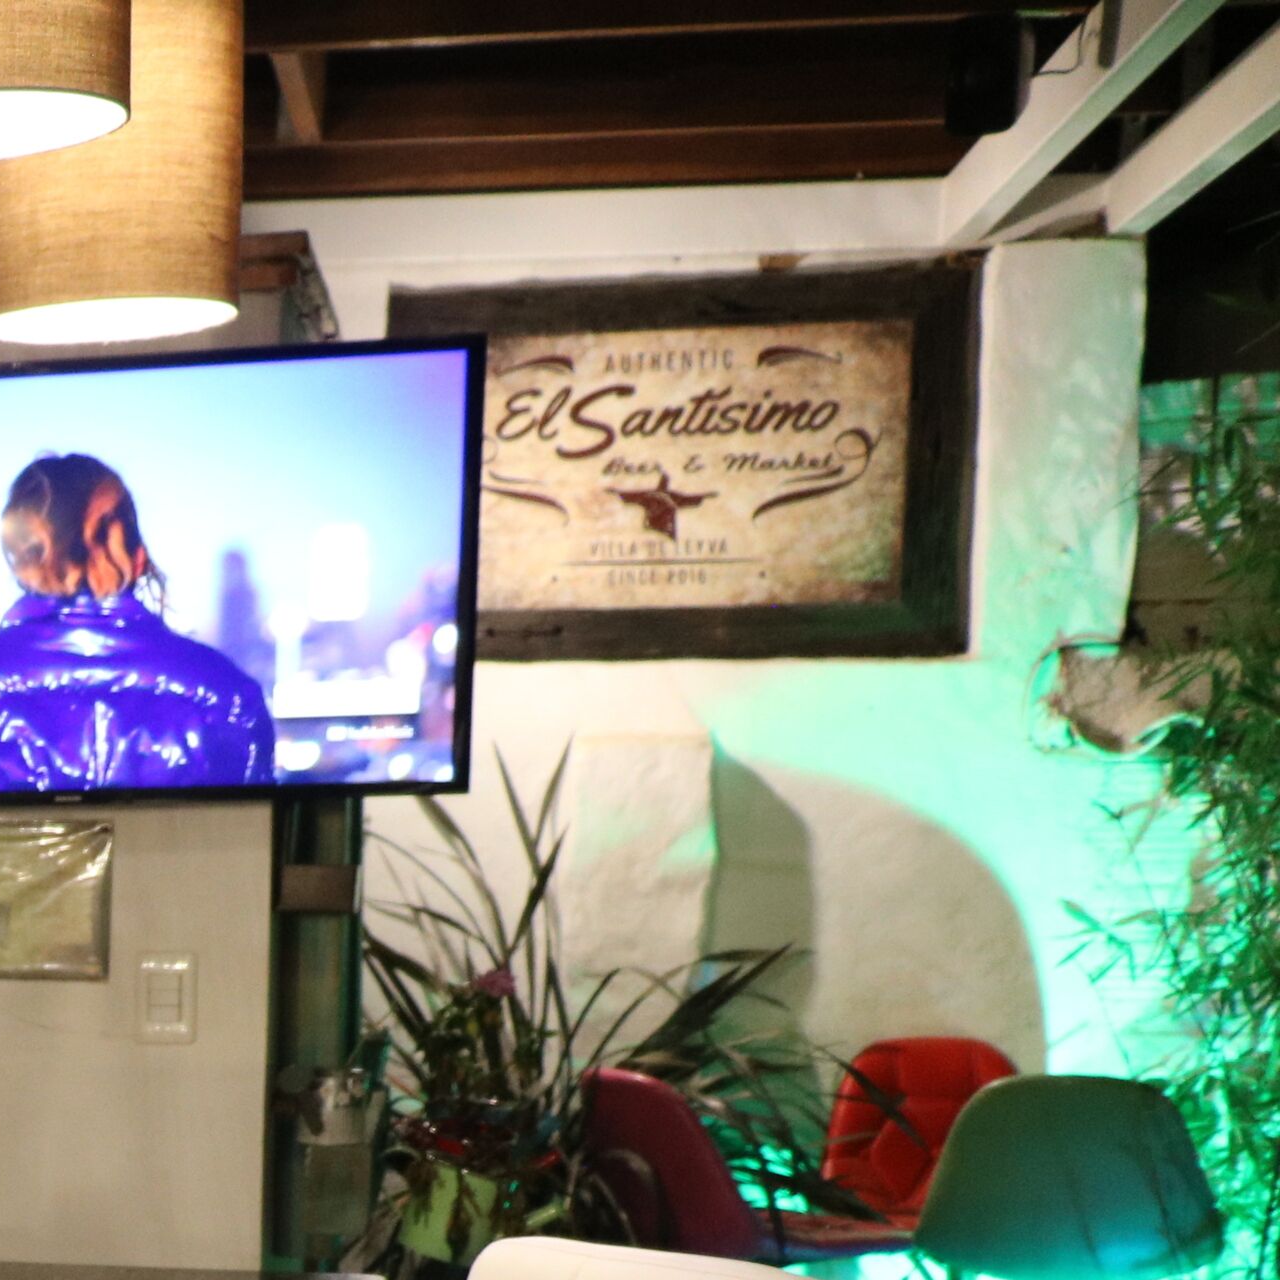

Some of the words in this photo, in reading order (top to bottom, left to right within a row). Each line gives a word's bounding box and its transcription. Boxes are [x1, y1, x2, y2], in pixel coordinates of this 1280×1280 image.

[604, 351, 734, 375] AUTHENTIC
[496, 386, 573, 440] El
[602, 453, 662, 476] Beer
[682, 455, 705, 473] &
[723, 452, 837, 472] Market
[590, 541, 639, 558] VILLA
[606, 570, 660, 587] SINCE
